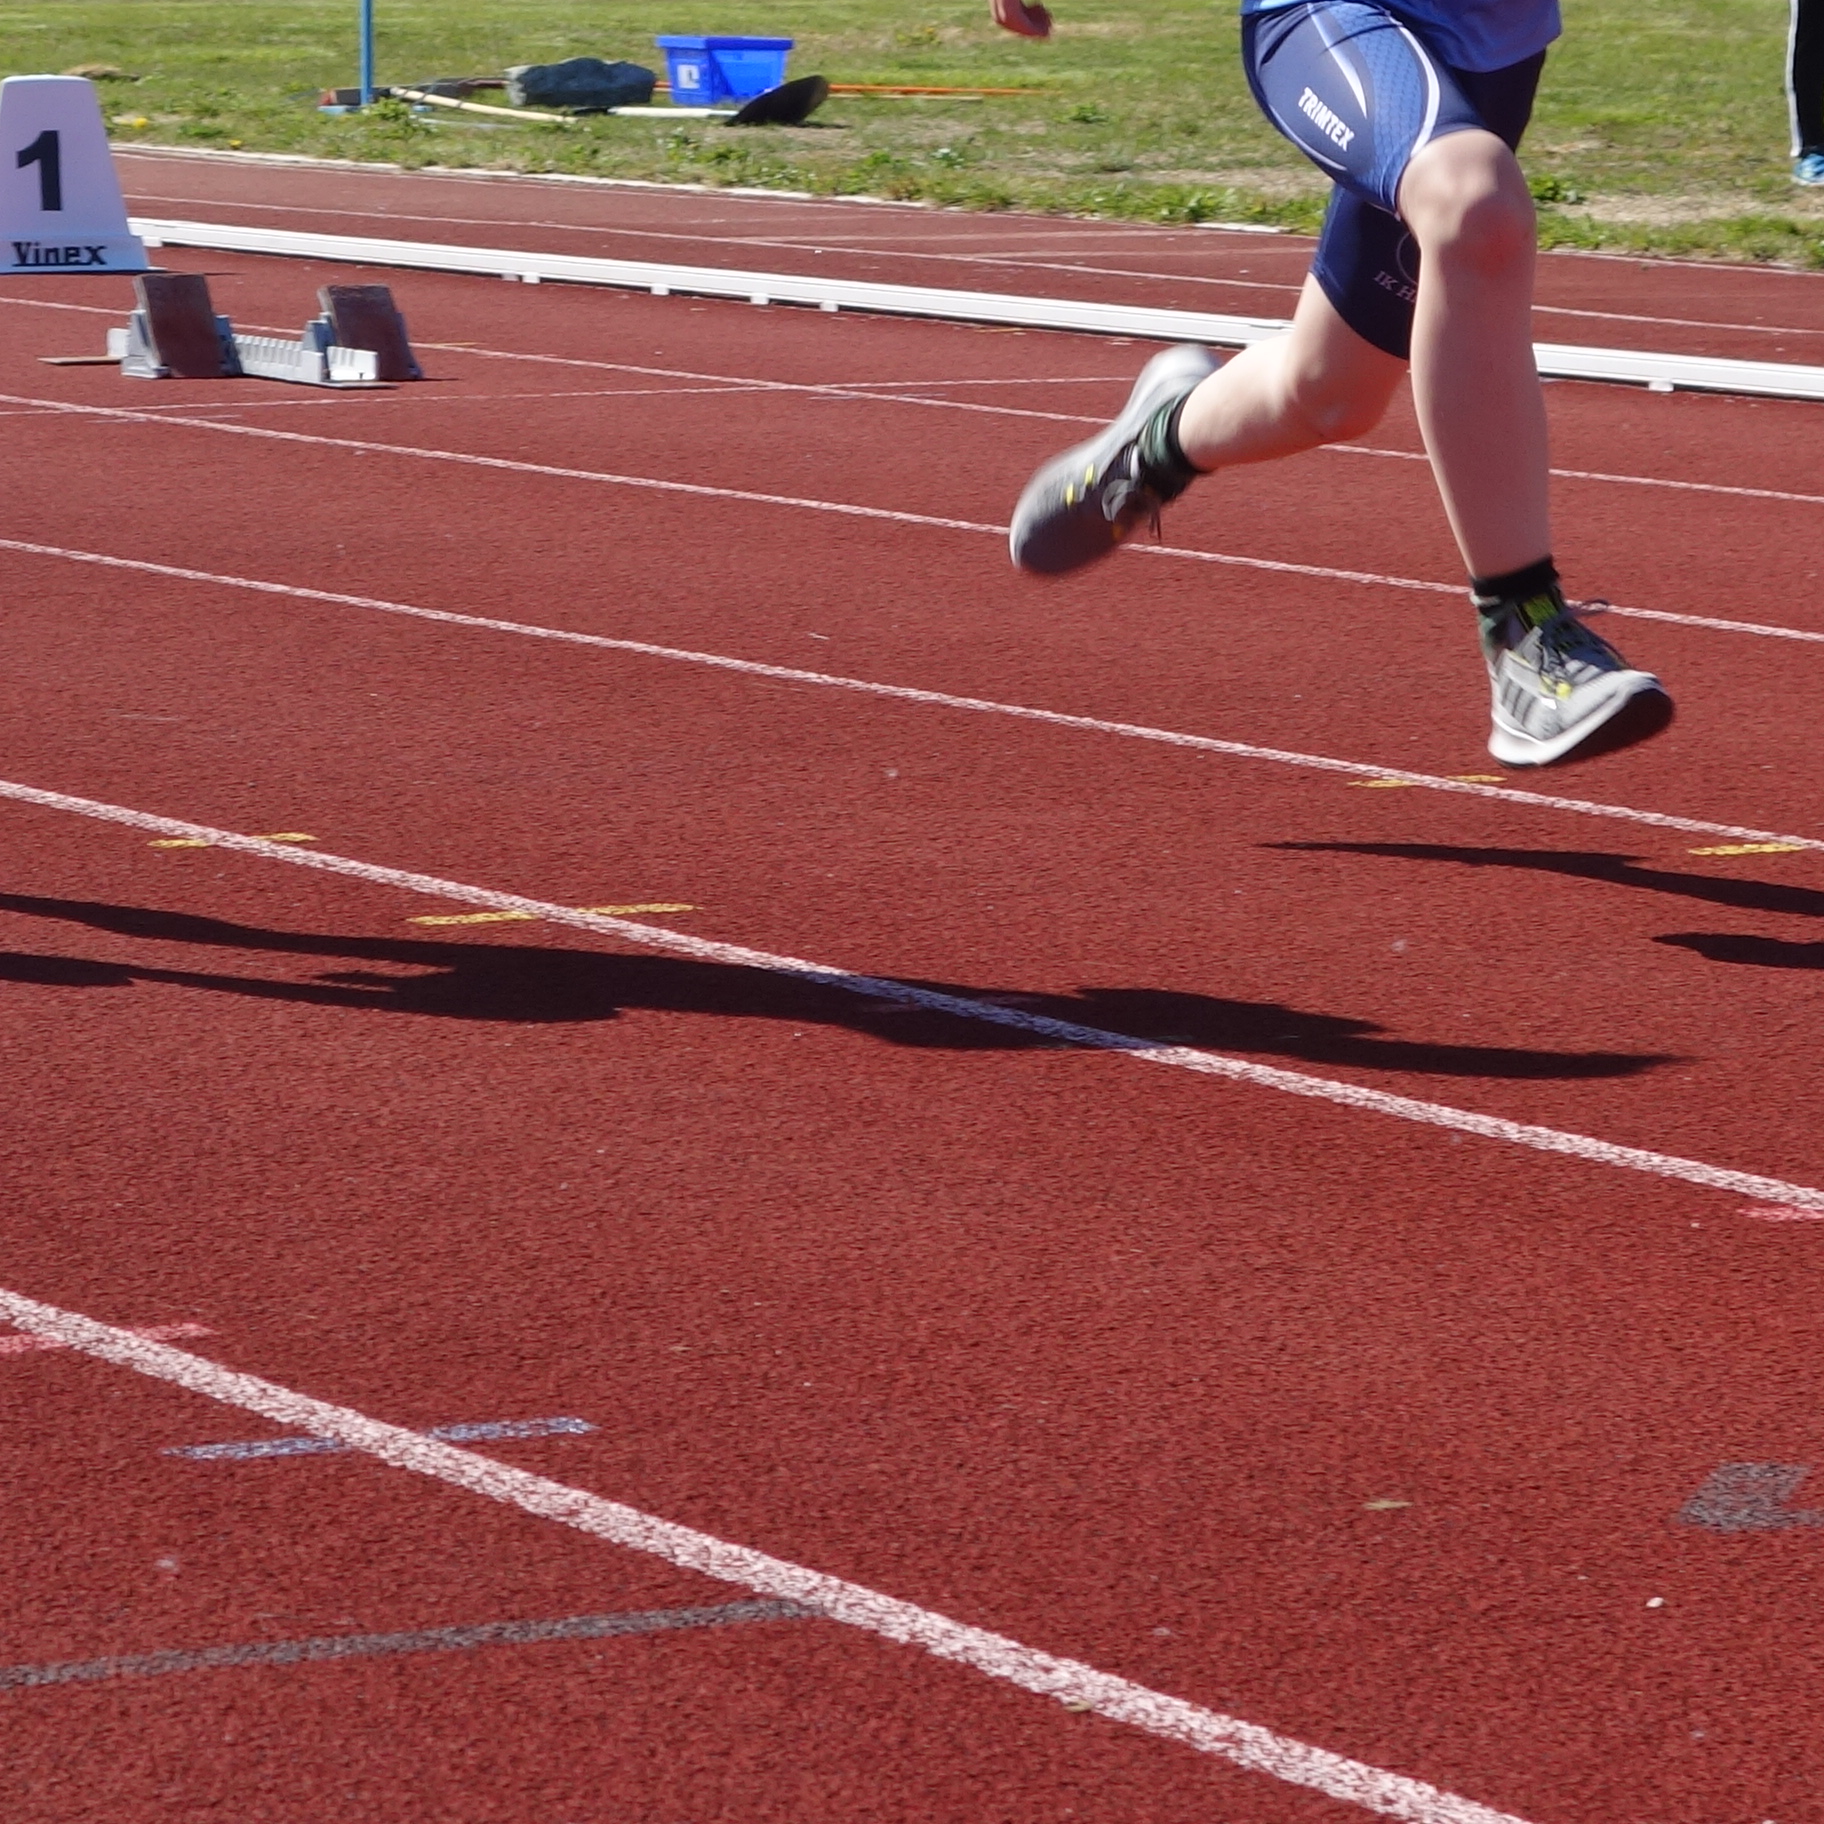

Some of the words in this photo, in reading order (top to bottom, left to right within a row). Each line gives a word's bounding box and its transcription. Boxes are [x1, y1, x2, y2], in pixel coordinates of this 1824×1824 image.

[1298, 85, 1355, 153] TRIMTEX
[16, 129, 62, 212] 1
[11, 241, 107, 268] Vinex
[1373, 269, 1398, 291] IK
